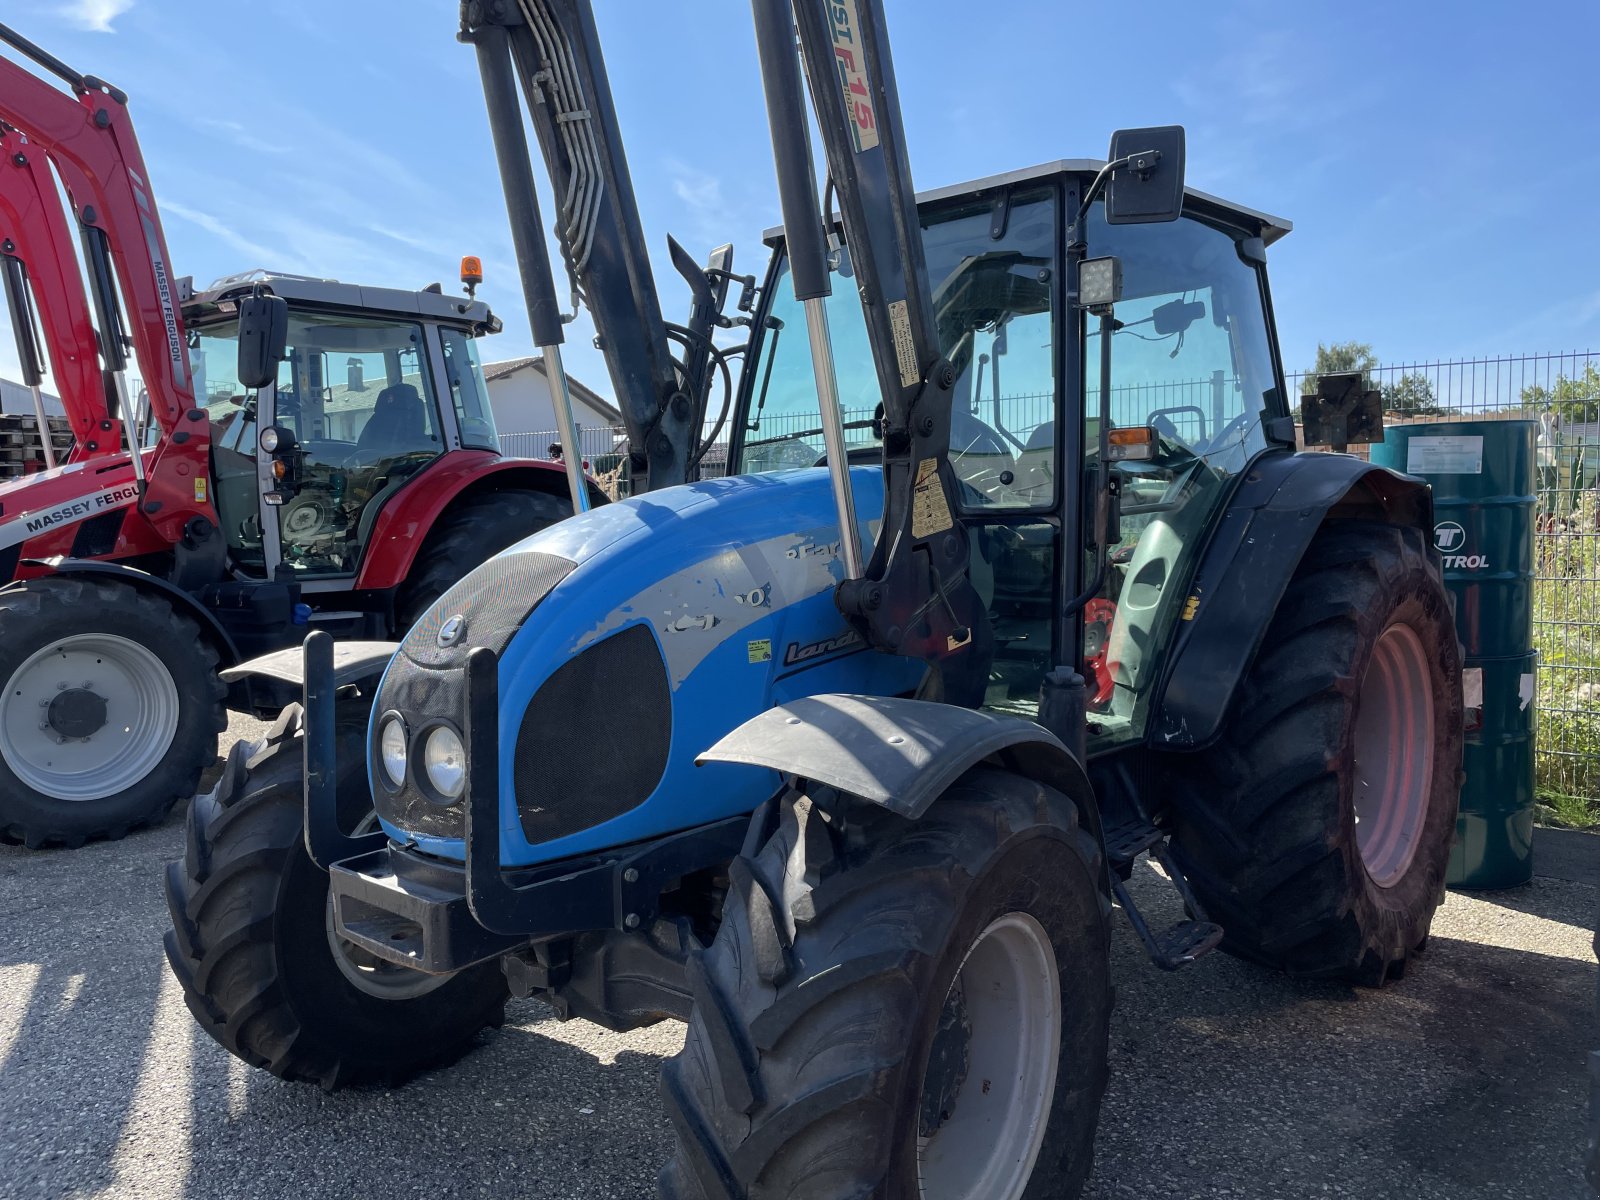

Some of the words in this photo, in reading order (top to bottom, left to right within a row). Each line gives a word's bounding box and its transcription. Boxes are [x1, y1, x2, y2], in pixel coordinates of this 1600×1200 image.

[154, 261, 171, 304] MASSEY
[164, 307, 181, 362] FERGUSON
[26, 500, 90, 533] MASSEY
[1442, 555, 1489, 569] TROL
